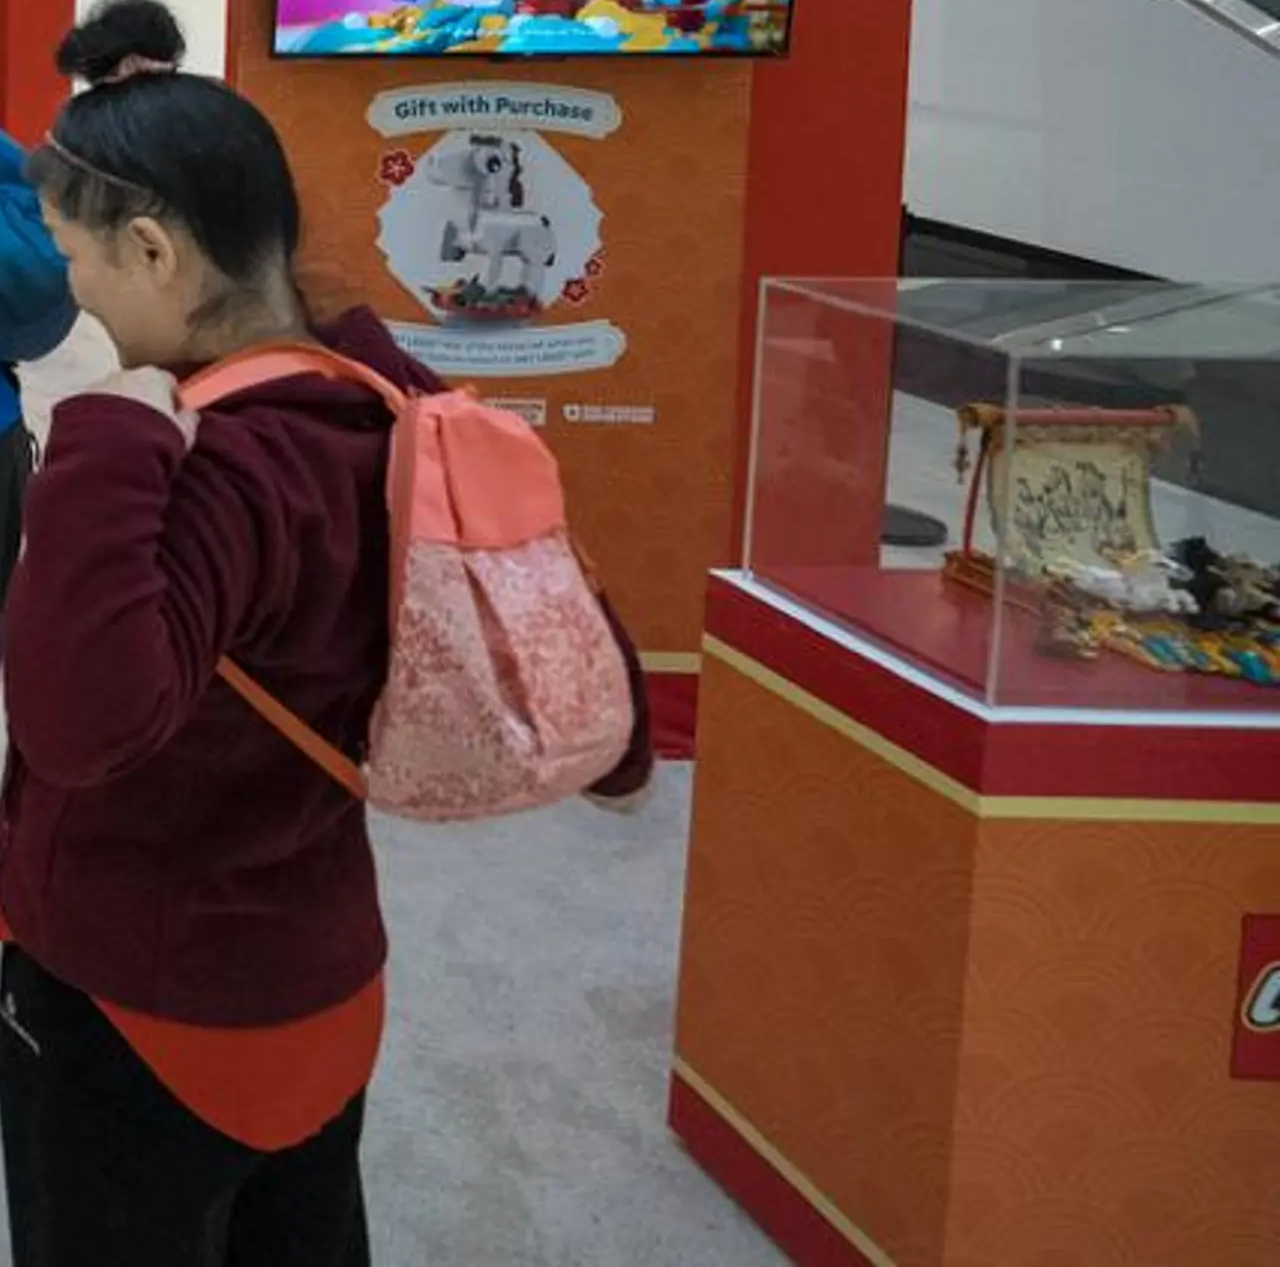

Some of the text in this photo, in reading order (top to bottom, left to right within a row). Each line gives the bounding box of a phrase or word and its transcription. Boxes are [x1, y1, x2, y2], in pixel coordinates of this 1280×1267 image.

[394, 94, 594, 122] Gift with Purchase
